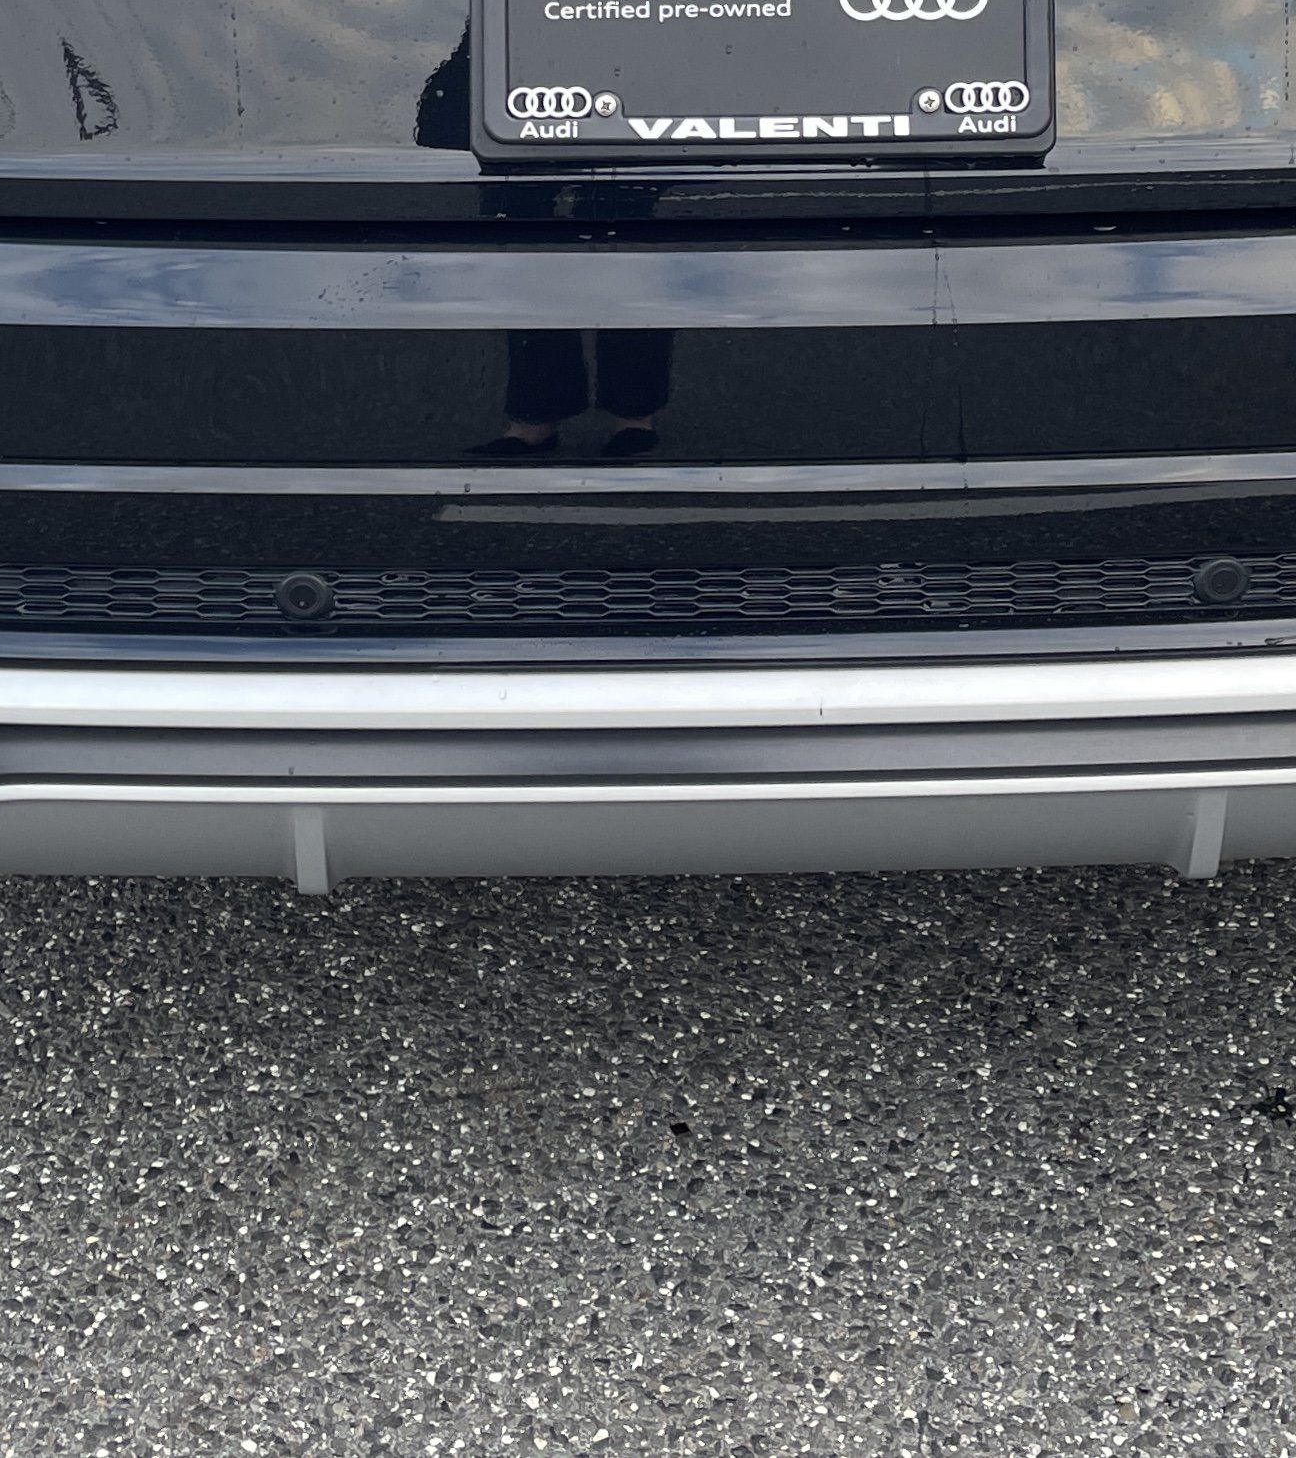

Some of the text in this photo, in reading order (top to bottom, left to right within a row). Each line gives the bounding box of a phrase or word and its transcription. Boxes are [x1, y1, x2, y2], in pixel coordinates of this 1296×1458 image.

[543, 0, 651, 20] Certified
[519, 120, 580, 139] Audi
[627, 115, 911, 140] VALENTI
[957, 115, 1018, 134] Audi
